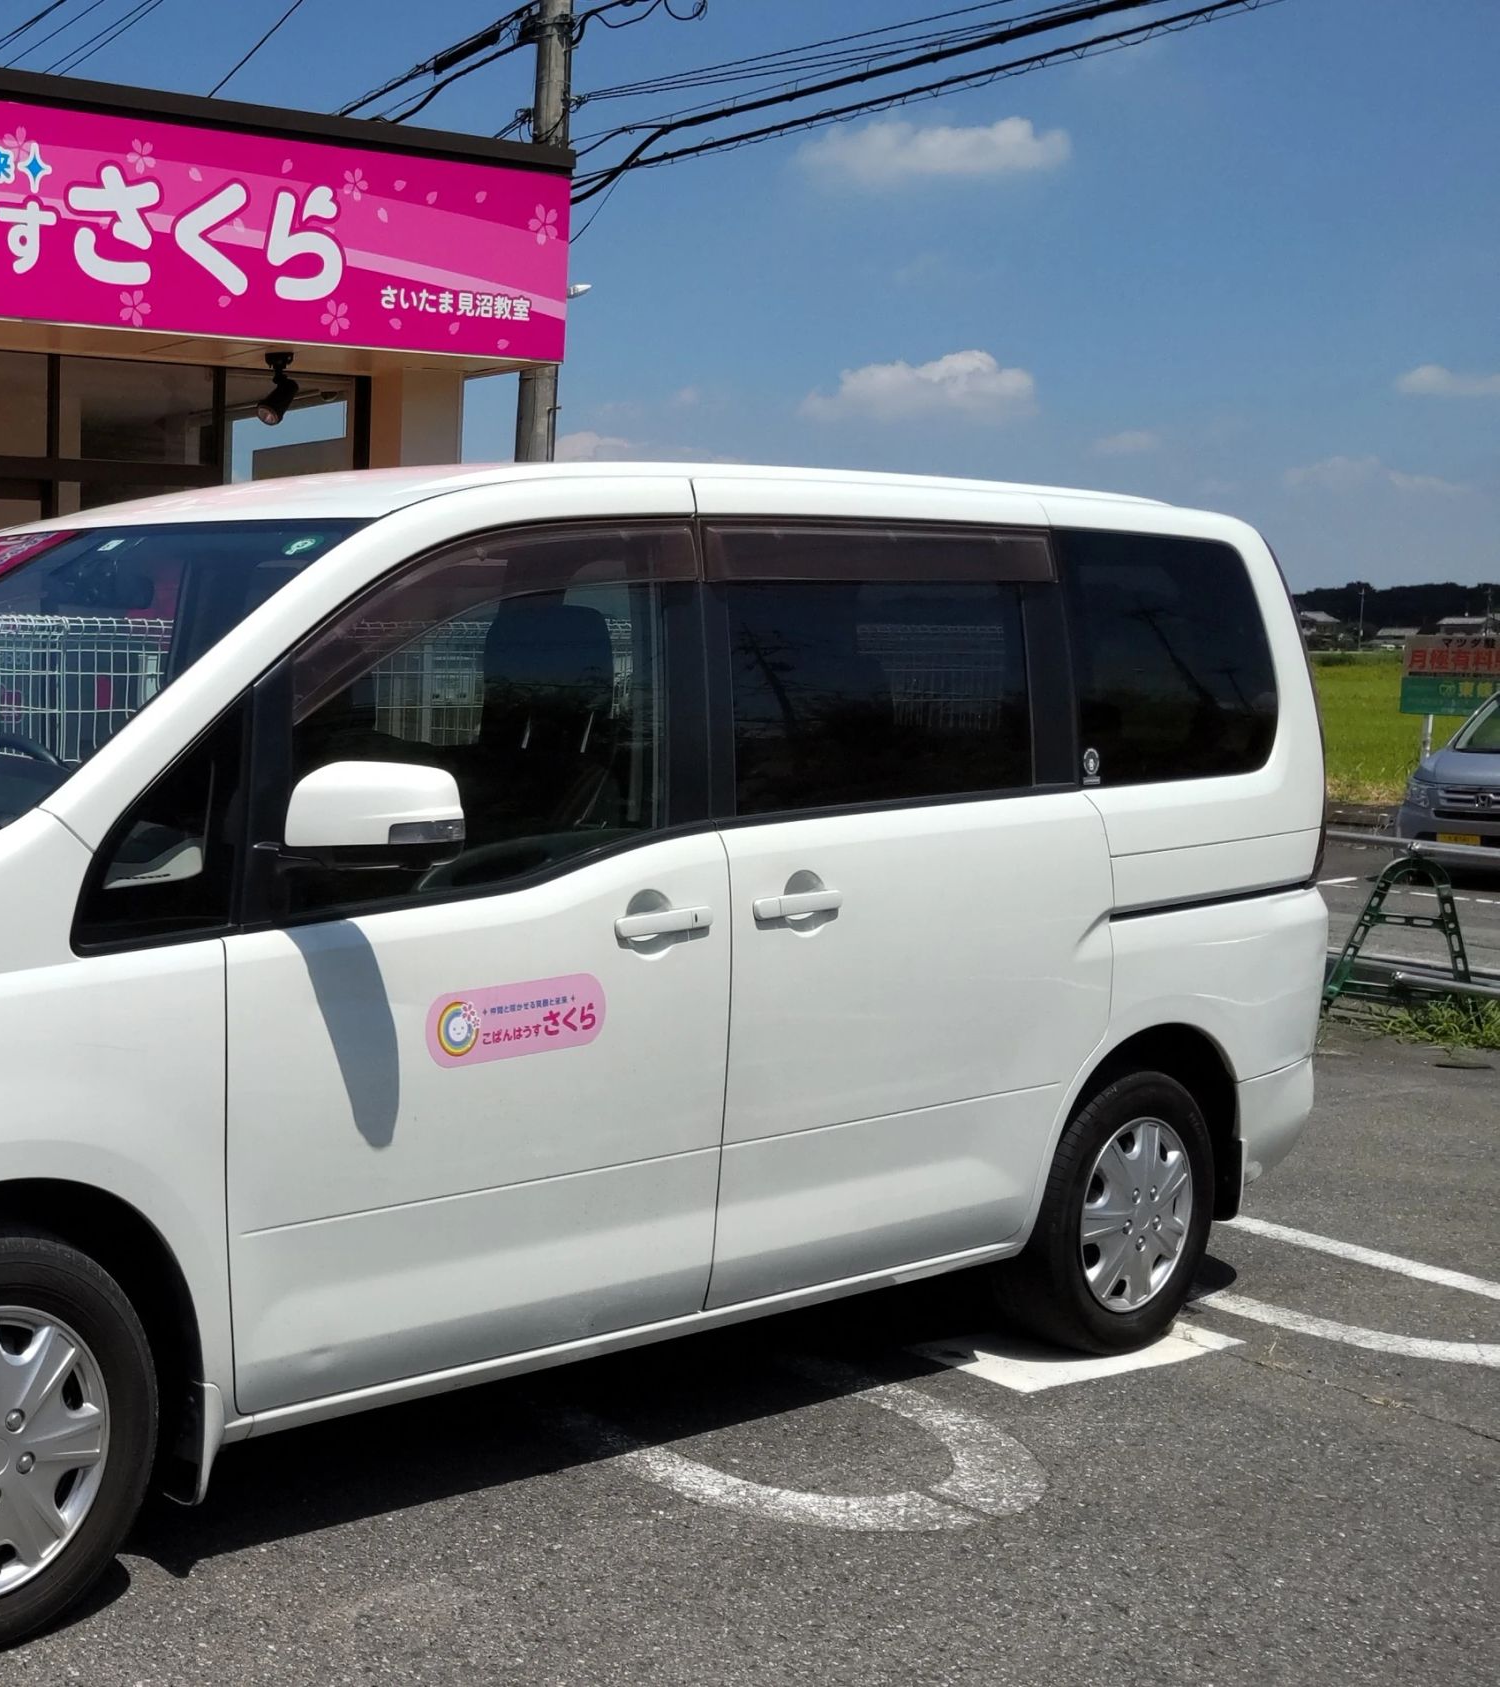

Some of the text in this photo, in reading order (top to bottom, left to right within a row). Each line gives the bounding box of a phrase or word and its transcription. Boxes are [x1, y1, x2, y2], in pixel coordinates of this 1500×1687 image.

[379, 284, 532, 323] さいたま見沼教室
